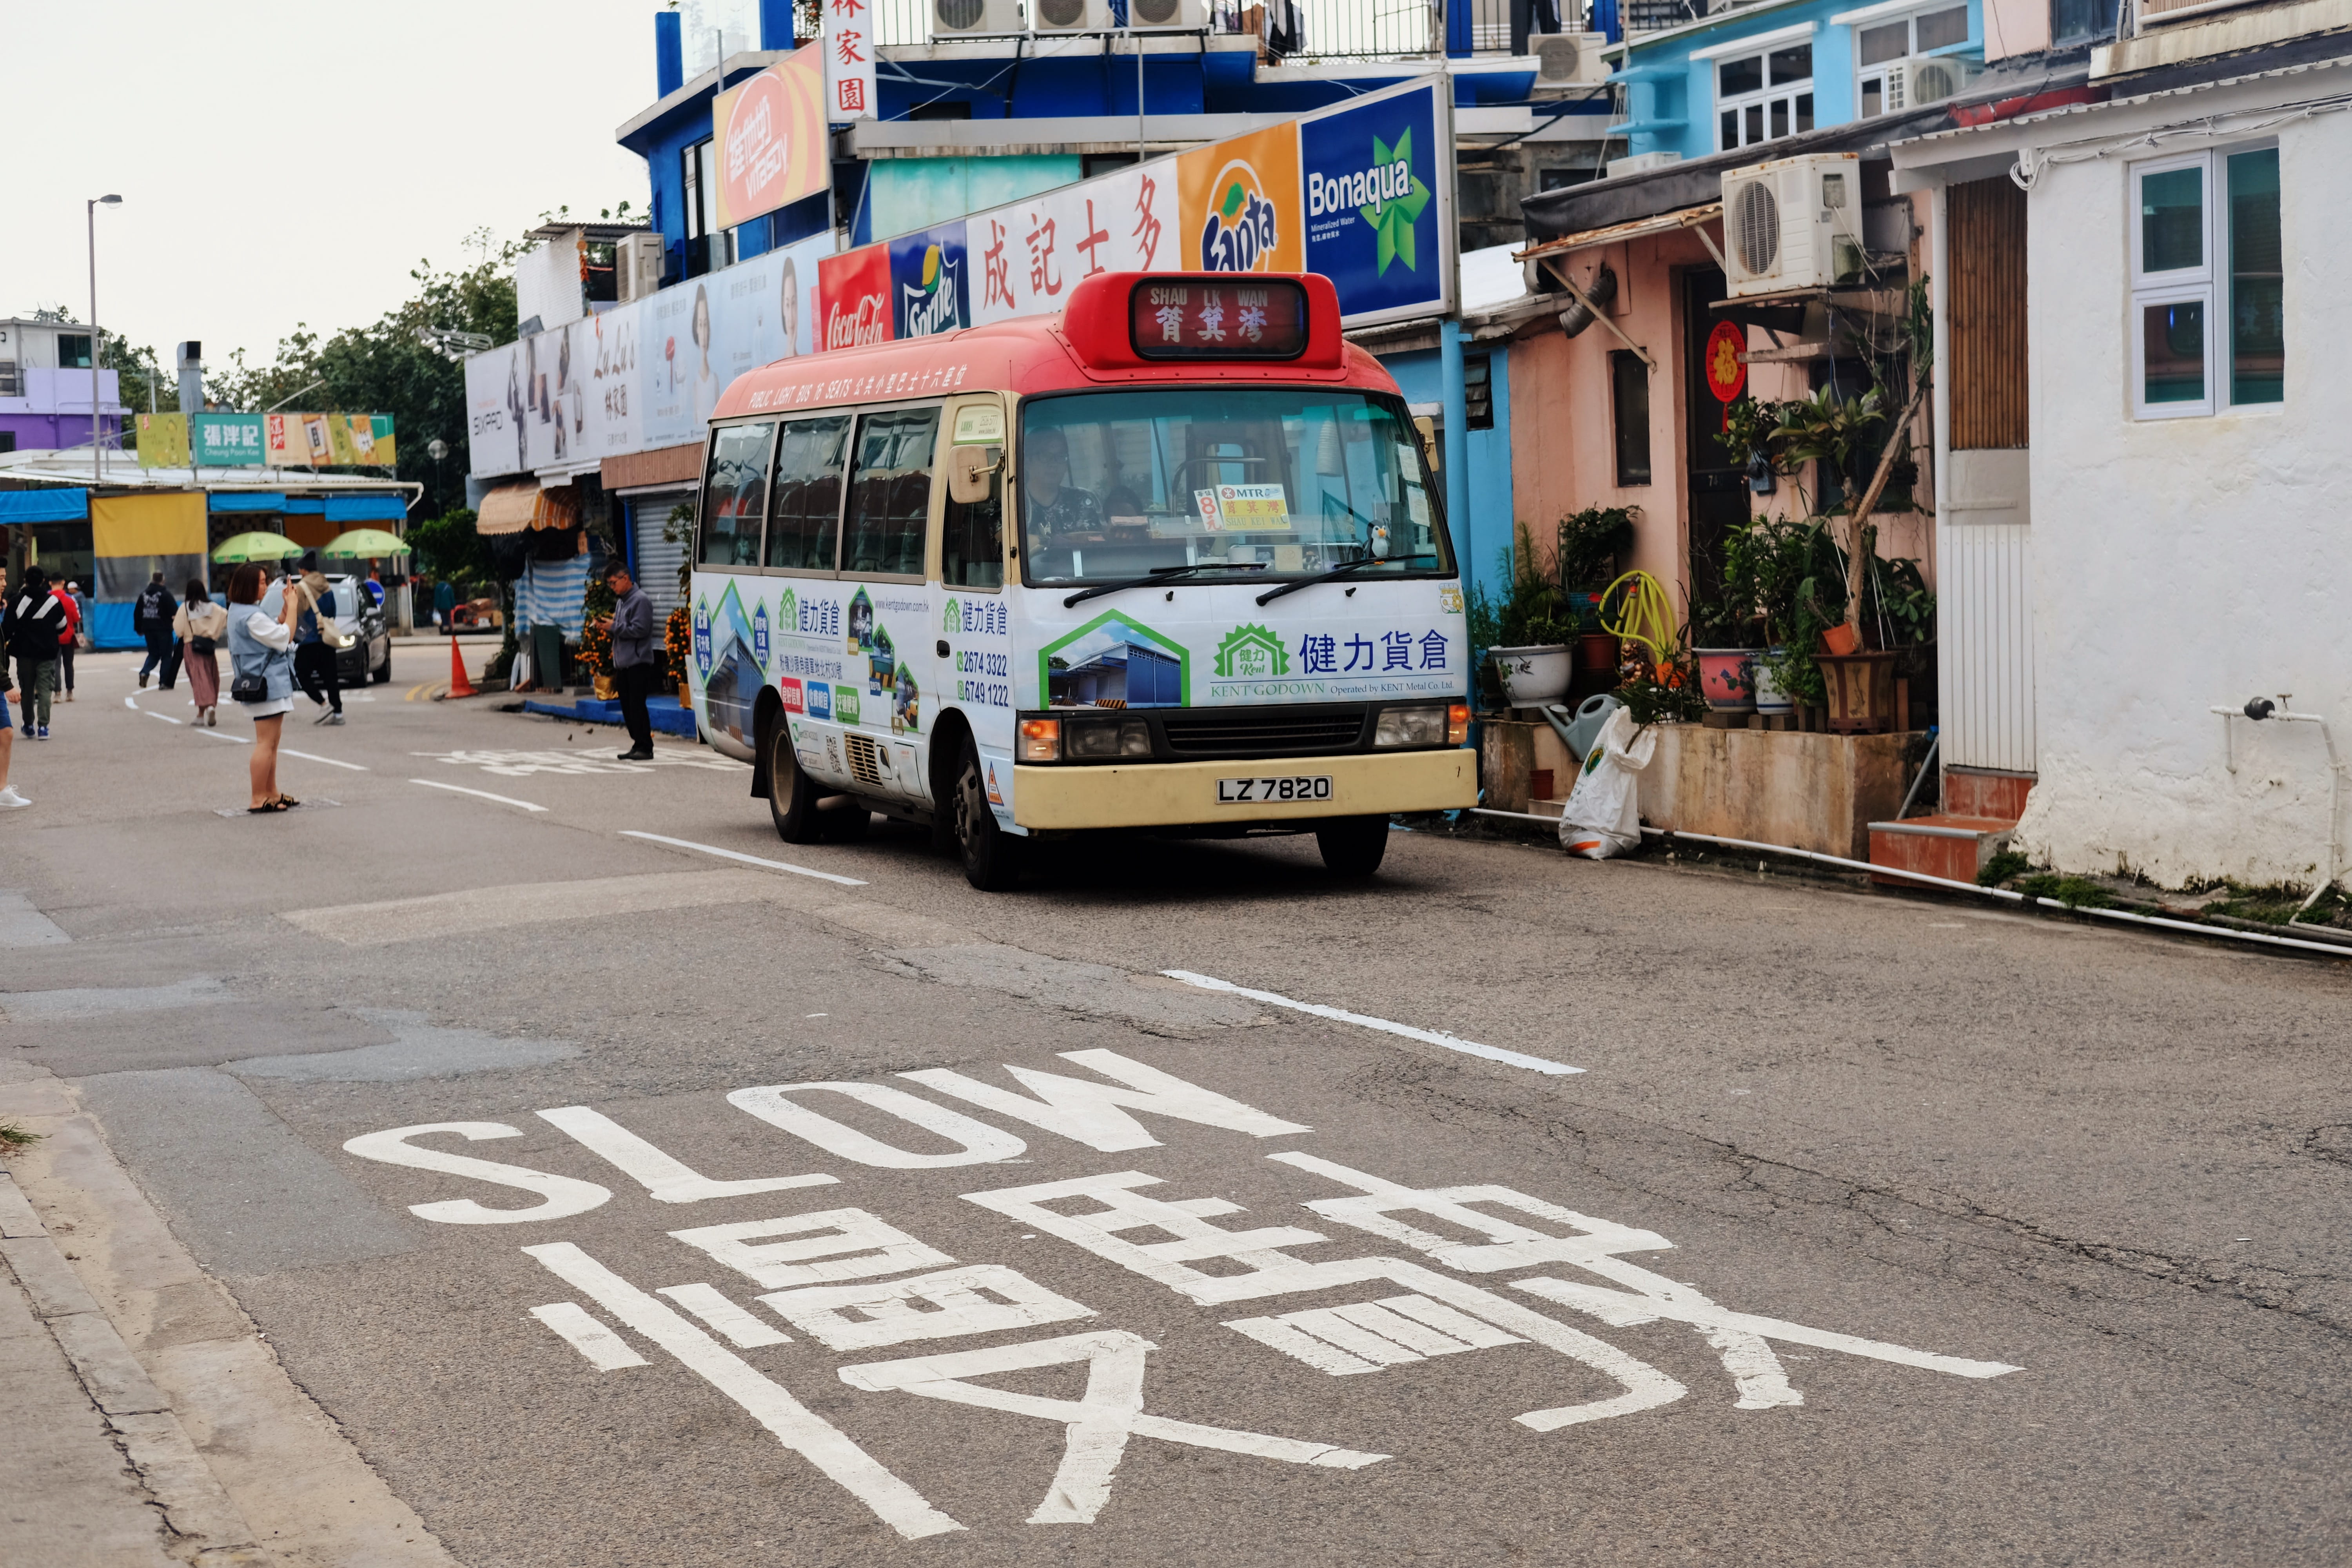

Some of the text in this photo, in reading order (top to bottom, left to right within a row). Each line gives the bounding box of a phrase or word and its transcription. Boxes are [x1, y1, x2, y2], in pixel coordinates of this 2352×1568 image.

[729, 95, 772, 183] 維他奶
[1309, 158, 1409, 216] Bonaqua
[1202, 193, 1276, 271] Fanta
[1311, 217, 1355, 232] Mineralized Water
[983, 174, 1161, 310] 成記士多
[909, 270, 953, 338] Sprite
[1150, 287, 1187, 305] SHAU
[1237, 290, 1268, 307] WAN
[854, 364, 967, 397] 公共小型巴士十六座位
[748, 378, 853, 410] PUBLIC LIGHT BUS 16 SEATS
[474, 410, 503, 436] SIXPAD
[204, 448, 229, 458] Cheung
[230, 448, 247, 456] Poon
[1200, 496, 1216, 515] 8
[1237, 488, 1264, 497] MTR
[1206, 515, 1223, 531] 元
[1226, 517, 1247, 526] SHAU
[1251, 517, 1265, 526] KEI
[799, 597, 840, 637] 健力貨倉
[875, 597, 929, 613] www.kentgodown.com.hk
[962, 599, 1007, 636] 健力貨倉
[756, 648, 768, 662] CCTV
[964, 650, 1007, 677] 2674 3322
[1239, 648, 1265, 662] 健力
[1299, 629, 1449, 675] 健力貨倉
[1240, 662, 1265, 677] Kent
[965, 681, 1009, 708] 6749 1222
[1210, 680, 1455, 697] KENT GODOWN Operated by KENT Metal Co. Ltd.
[837, 694, 857, 715] 交通便利
[1219, 777, 1329, 800] LZ 7820
[343, 1047, 1313, 1227] SLOW
[521, 1149, 2025, 1543] 慢駛
